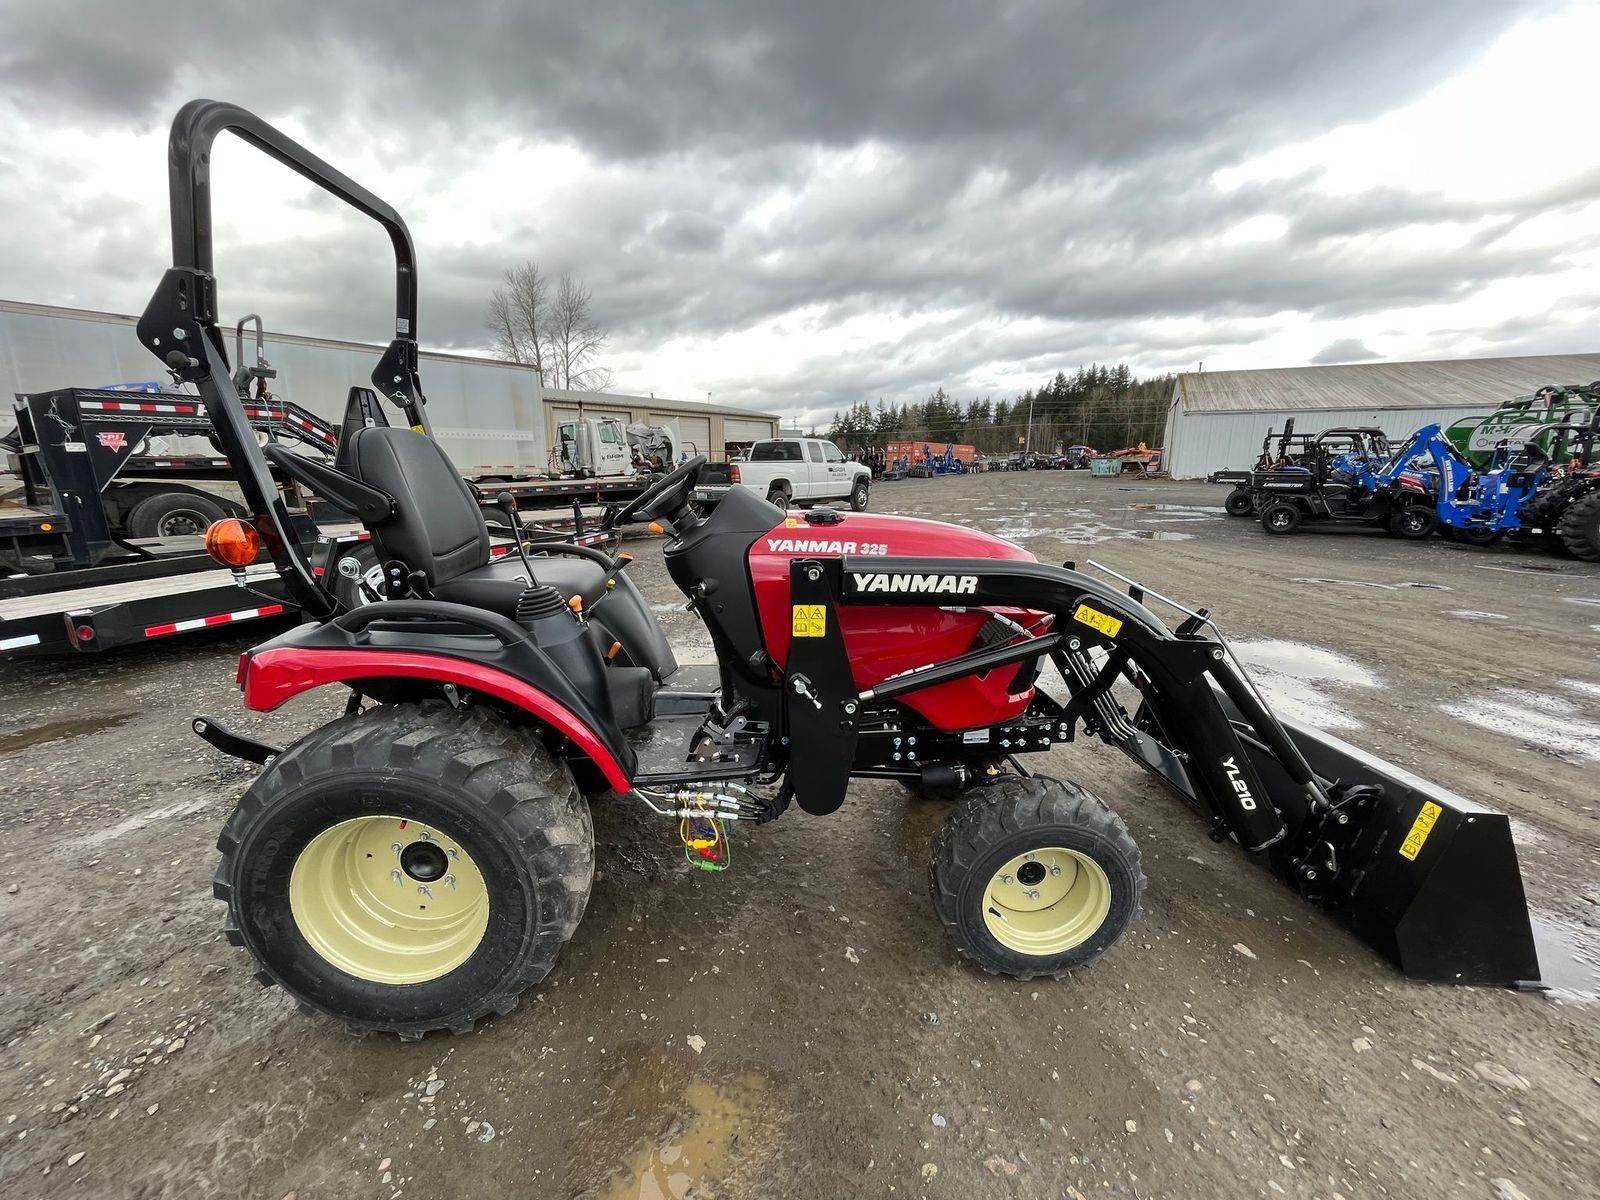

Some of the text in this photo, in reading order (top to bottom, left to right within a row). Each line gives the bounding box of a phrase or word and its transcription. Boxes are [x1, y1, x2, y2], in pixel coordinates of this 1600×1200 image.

[767, 539, 888, 555] YANMAR 325
[853, 573, 978, 594] YANMAR
[1222, 756, 1257, 810] YL210
